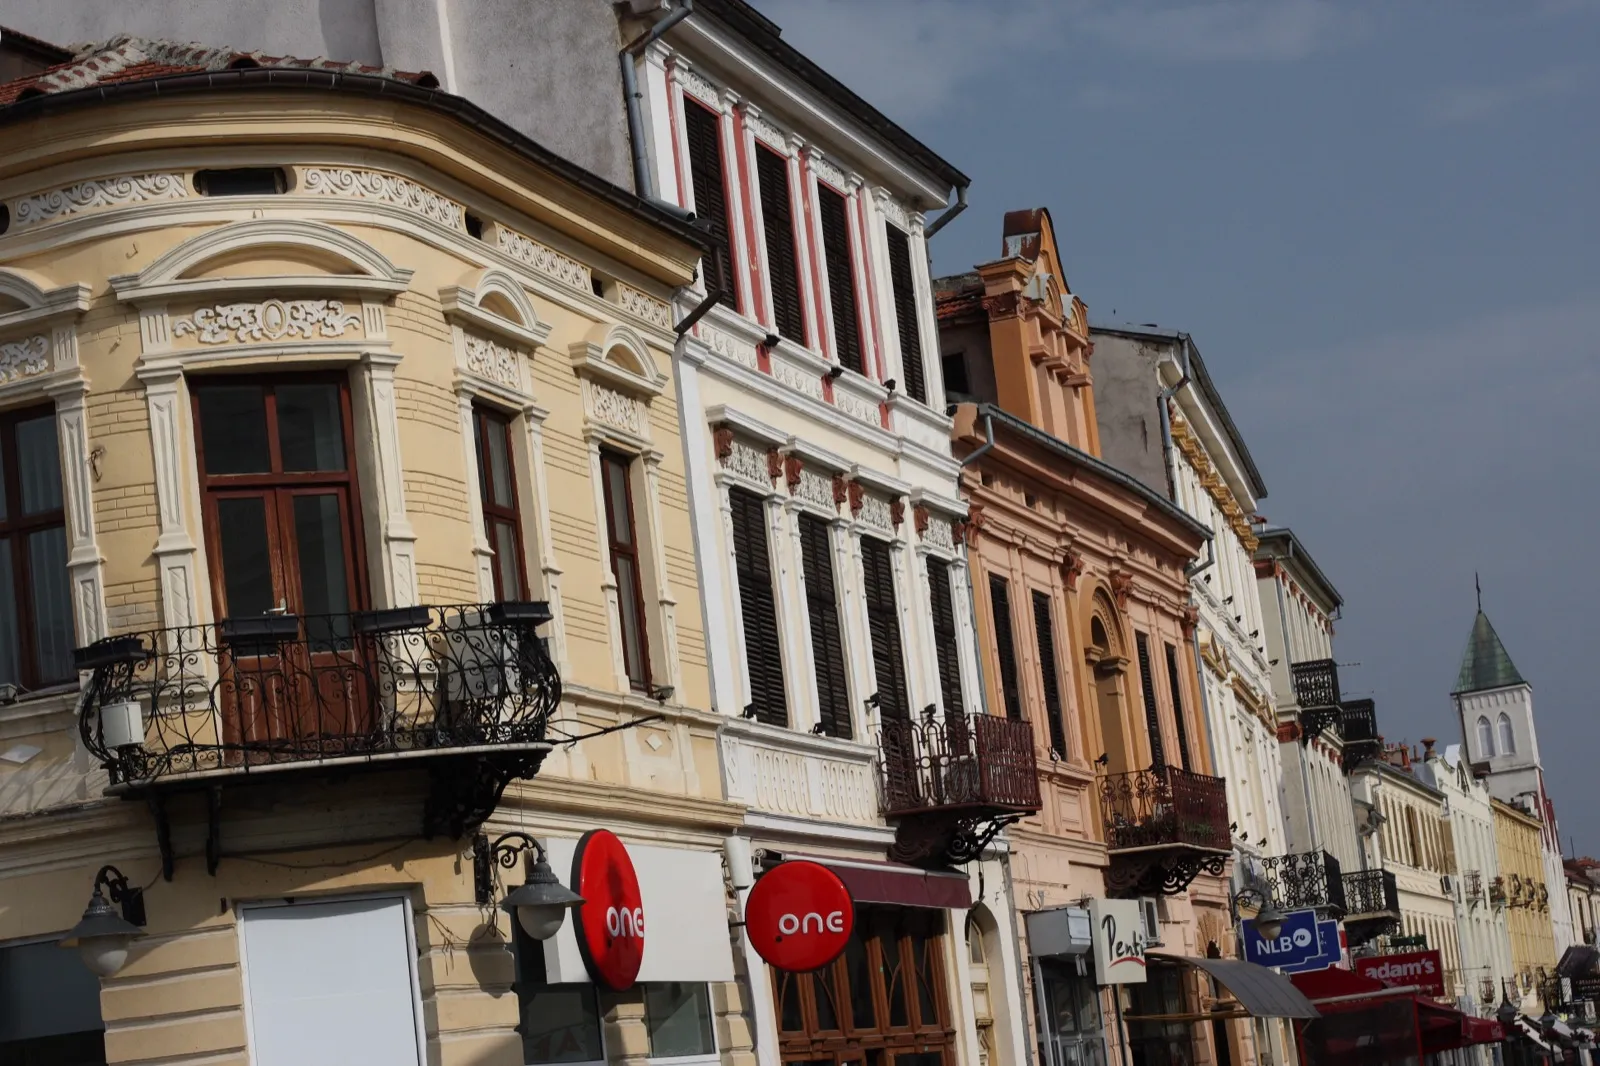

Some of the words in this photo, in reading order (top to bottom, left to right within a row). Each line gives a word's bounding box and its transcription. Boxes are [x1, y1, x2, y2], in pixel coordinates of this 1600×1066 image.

[1101, 914, 1144, 962] Penti
[1256, 936, 1293, 955] NLB
[1365, 958, 1435, 980] adam's
